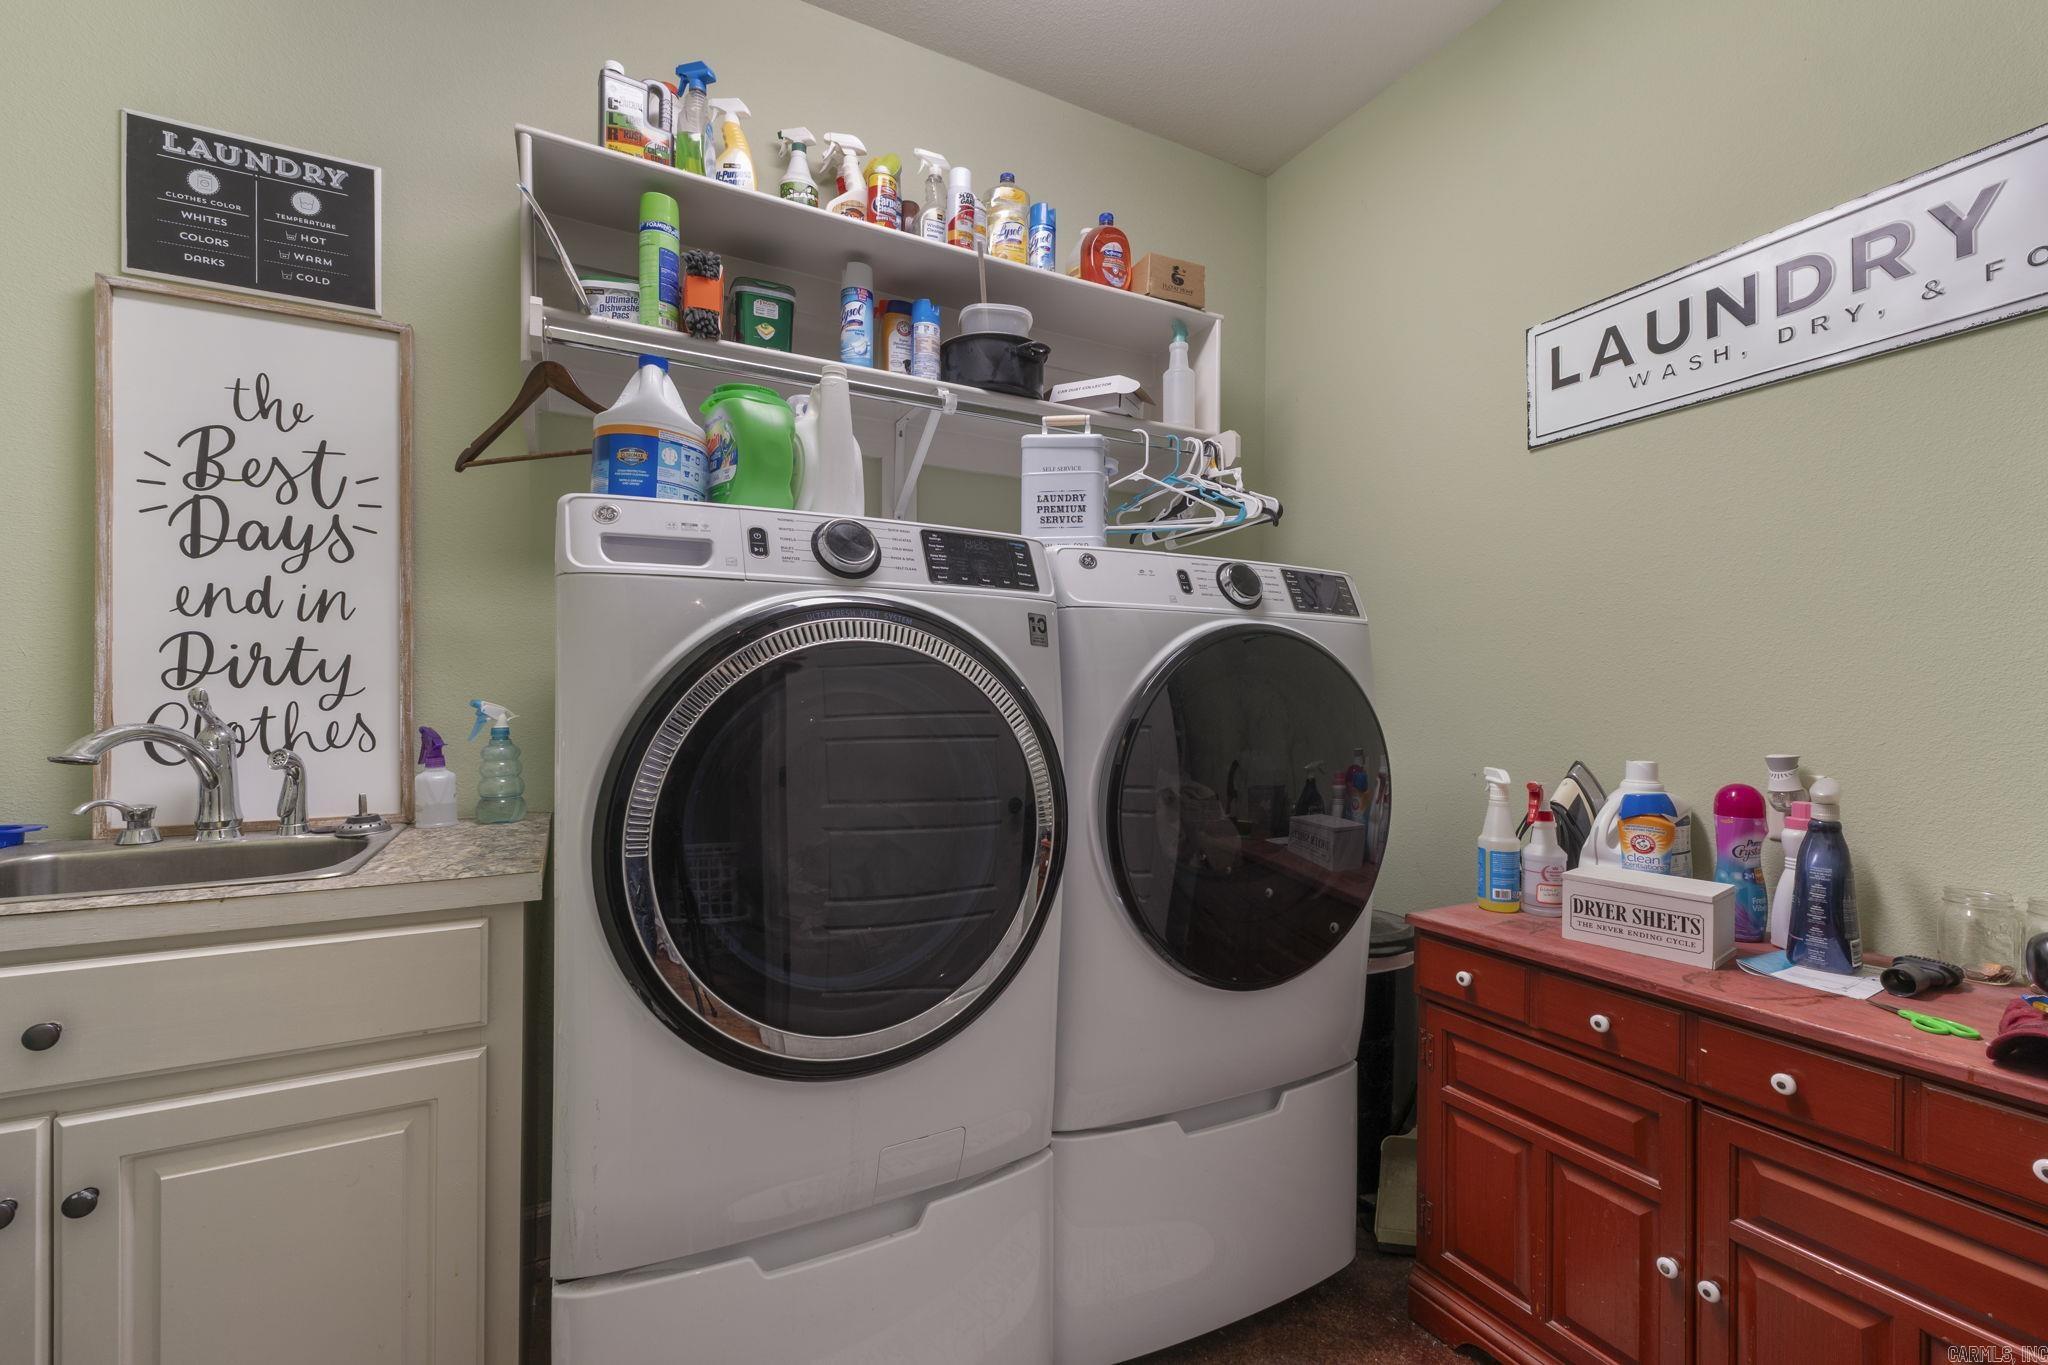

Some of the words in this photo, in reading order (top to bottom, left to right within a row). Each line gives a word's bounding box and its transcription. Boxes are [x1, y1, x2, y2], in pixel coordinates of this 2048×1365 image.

[162, 130, 349, 190] LAUNDRY
[165, 190, 208, 204] CLOTHES
[210, 199, 242, 212] COLOR
[181, 210, 228, 227] WHITES
[275, 212, 337, 230] TEMPERATURE
[179, 231, 230, 248] COLORS
[300, 234, 327, 246] HOT
[184, 253, 226, 267] DARKS
[293, 252, 333, 267] WARM
[296, 273, 331, 286] COLD
[1550, 178, 2009, 392] LAUNDRY
[599, 303, 640, 313] Dishwashe
[604, 295, 639, 305] Ultimate
[611, 312, 630, 320] Pacs
[1628, 344, 1749, 390] WASH,
[1777, 303, 1886, 346] DRY,
[1921, 278, 1947, 301] &
[1984, 244, 2048, 283] FO
[224, 372, 314, 433] the
[176, 423, 348, 510] Best
[1036, 493, 1087, 503] LAUNDRY
[1036, 504, 1087, 514] PREMIUM
[1039, 515, 1084, 524] SERVICE
[168, 493, 356, 574] Days
[169, 574, 285, 618] end
[296, 583, 357, 624] in
[806, 608, 856, 621] ULTRAFRESH
[859, 609, 880, 618] VENT
[883, 613, 913, 626] SYSTEM
[158, 630, 367, 712] Dirty
[1626, 852, 1661, 865] clean
[1573, 897, 1627, 923] DRYER
[1632, 909, 1701, 936] SHEETS
[1576, 920, 1594, 929] THE
[1596, 923, 1625, 936] NEVER
[1627, 929, 1663, 942] ENDING
[1666, 936, 1697, 948] CYCLE
